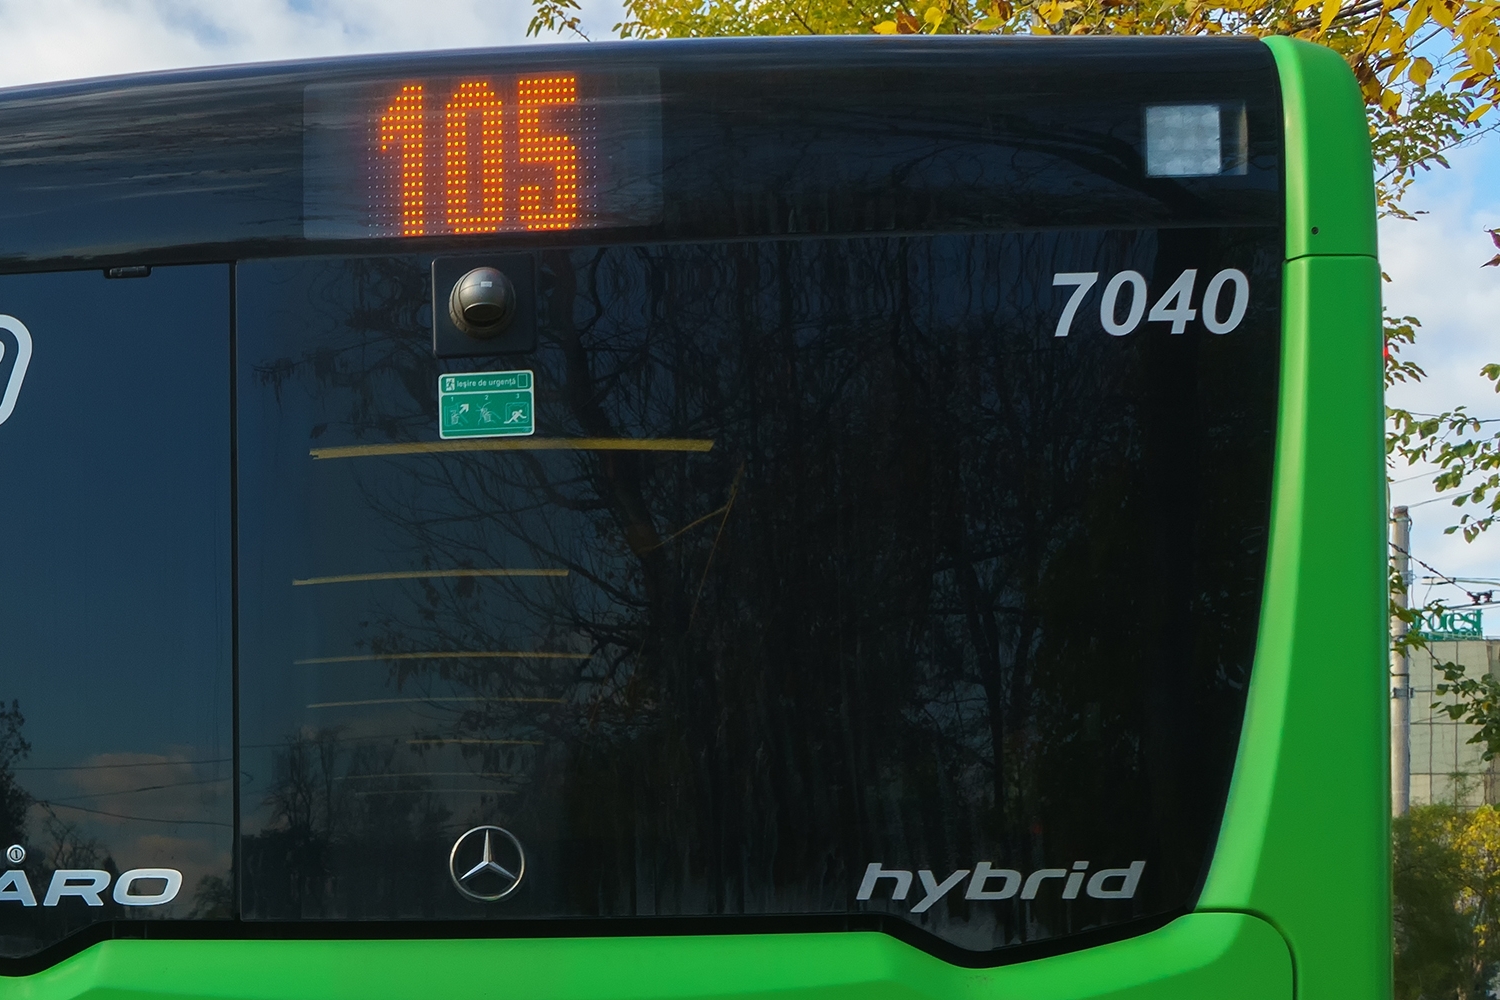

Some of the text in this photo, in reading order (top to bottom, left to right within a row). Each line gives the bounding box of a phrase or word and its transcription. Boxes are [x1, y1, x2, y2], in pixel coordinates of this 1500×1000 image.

[380, 75, 578, 237] 105
[1052, 268, 1250, 337] 7040
[478, 379, 487, 387] de
[855, 860, 1147, 914] hybrid
